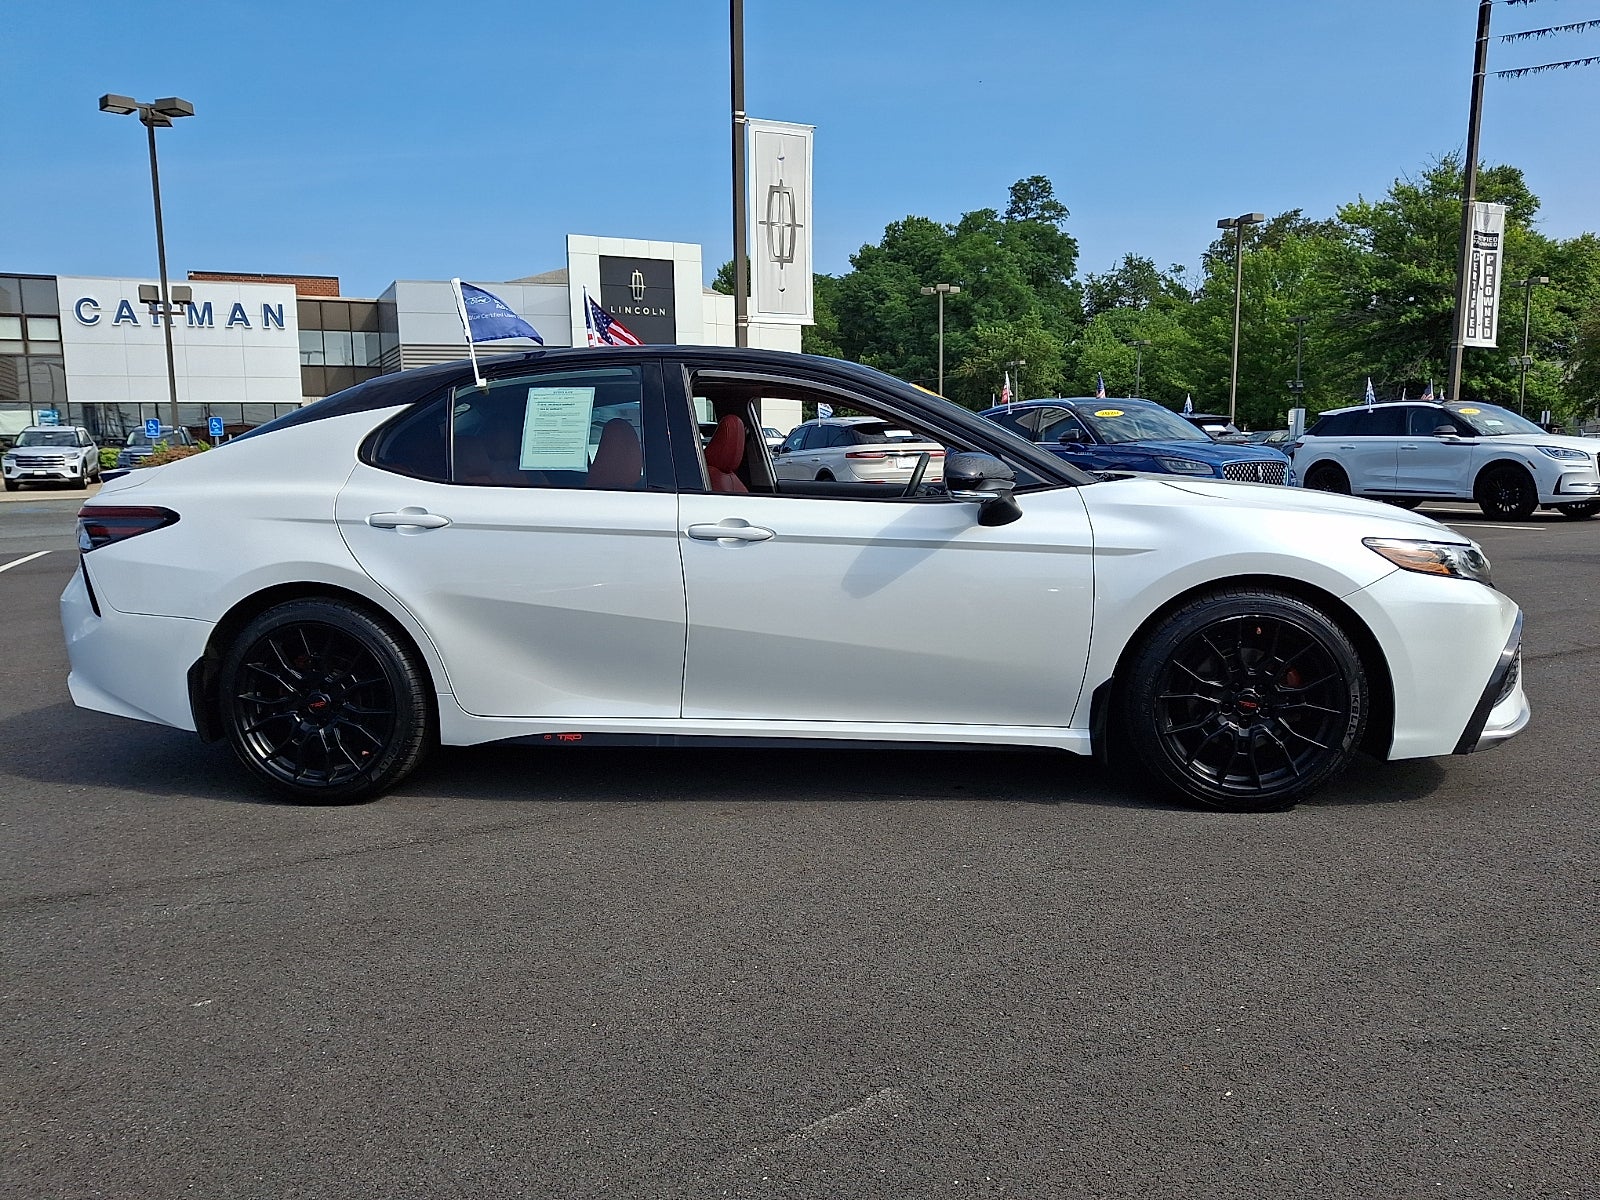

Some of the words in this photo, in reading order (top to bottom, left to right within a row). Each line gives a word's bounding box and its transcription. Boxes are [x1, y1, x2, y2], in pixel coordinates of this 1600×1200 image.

[74, 297, 285, 329] CARMAN
[610, 305, 666, 316] LINCOLN
[1468, 252, 1480, 337] CERTIFIED
[1484, 255, 1493, 337] PREOWNED
[1346, 693, 1360, 740] KELLY
[557, 733, 582, 741] TRD
